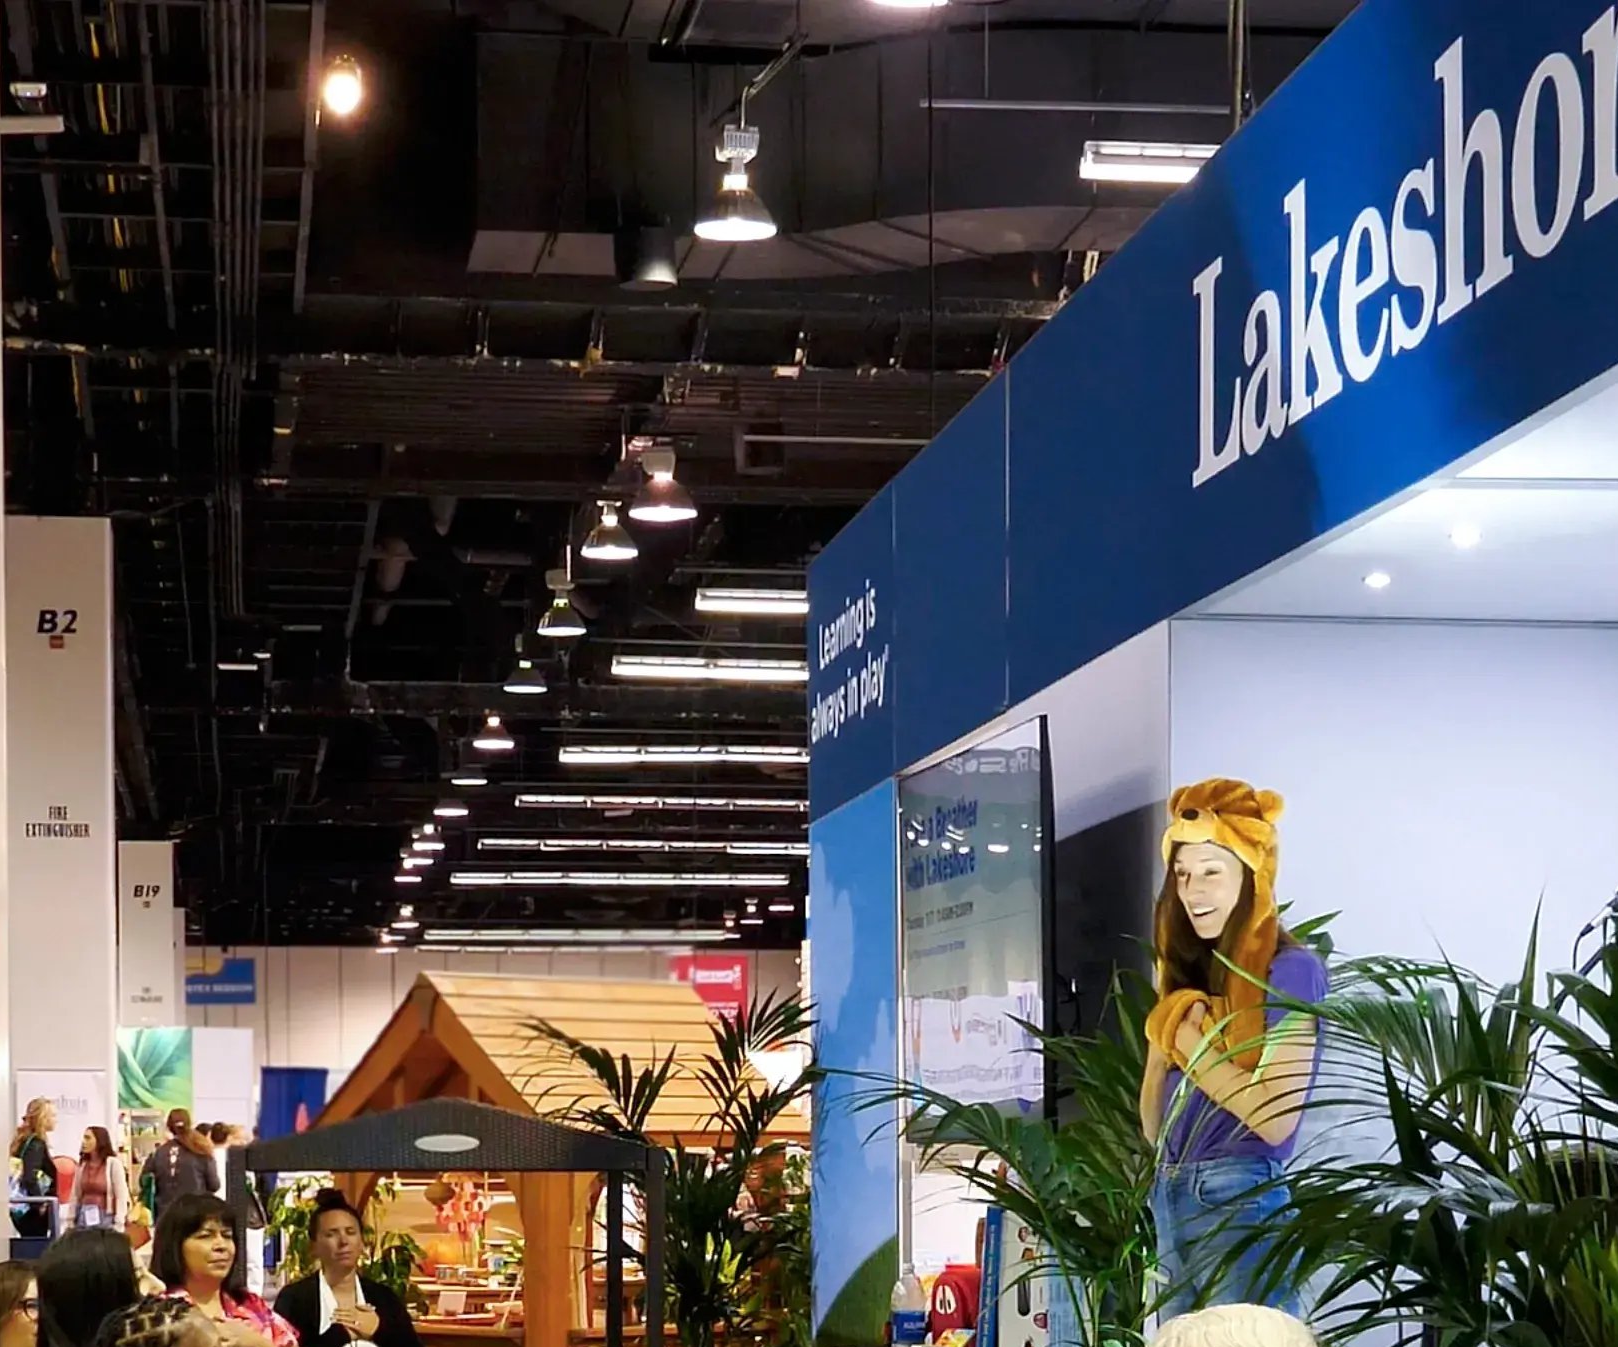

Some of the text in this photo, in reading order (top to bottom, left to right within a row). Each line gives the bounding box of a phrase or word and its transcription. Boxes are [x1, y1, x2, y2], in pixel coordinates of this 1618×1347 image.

[36, 608, 79, 635] B2
[818, 578, 876, 671] Learning is
[810, 692, 846, 745] always
[846, 667, 859, 718] in
[48, 805, 68, 822] FIRE
[25, 823, 90, 839] EXTINGUISHER
[133, 884, 160, 898] B19
